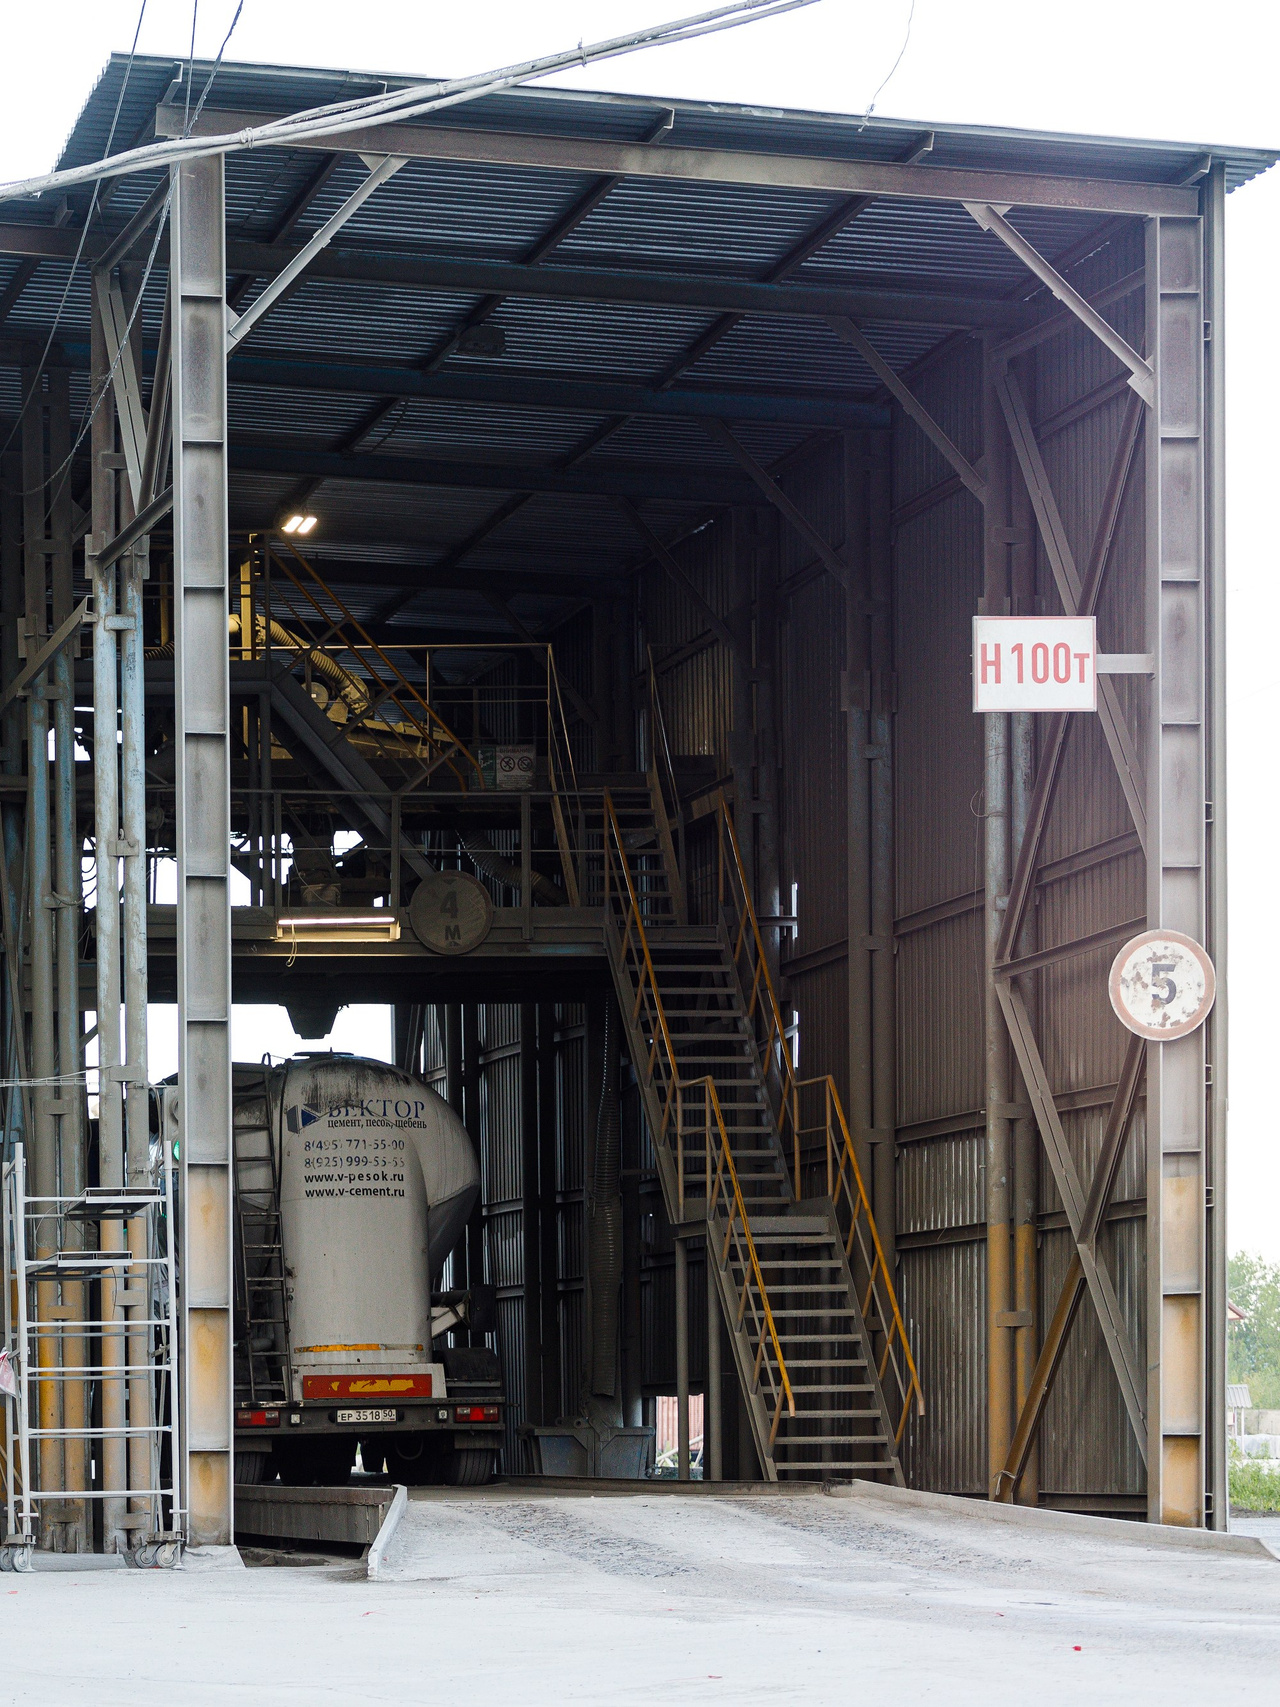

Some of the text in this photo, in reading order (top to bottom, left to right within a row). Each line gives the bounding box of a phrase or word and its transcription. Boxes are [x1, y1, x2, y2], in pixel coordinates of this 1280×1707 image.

[440, 891, 459, 919] 4
[1151, 963, 1177, 1006] 5
[328, 1098, 426, 1119] ВЕКТОР
[395, 1117, 428, 1129] щебень
[345, 1139, 405, 1151] 771-55-00
[304, 1171, 404, 1183] www.v-pesok.ru
[305, 1186, 405, 1198] www.v-cement.ru
[355, 1410, 381, 1420] 3518
